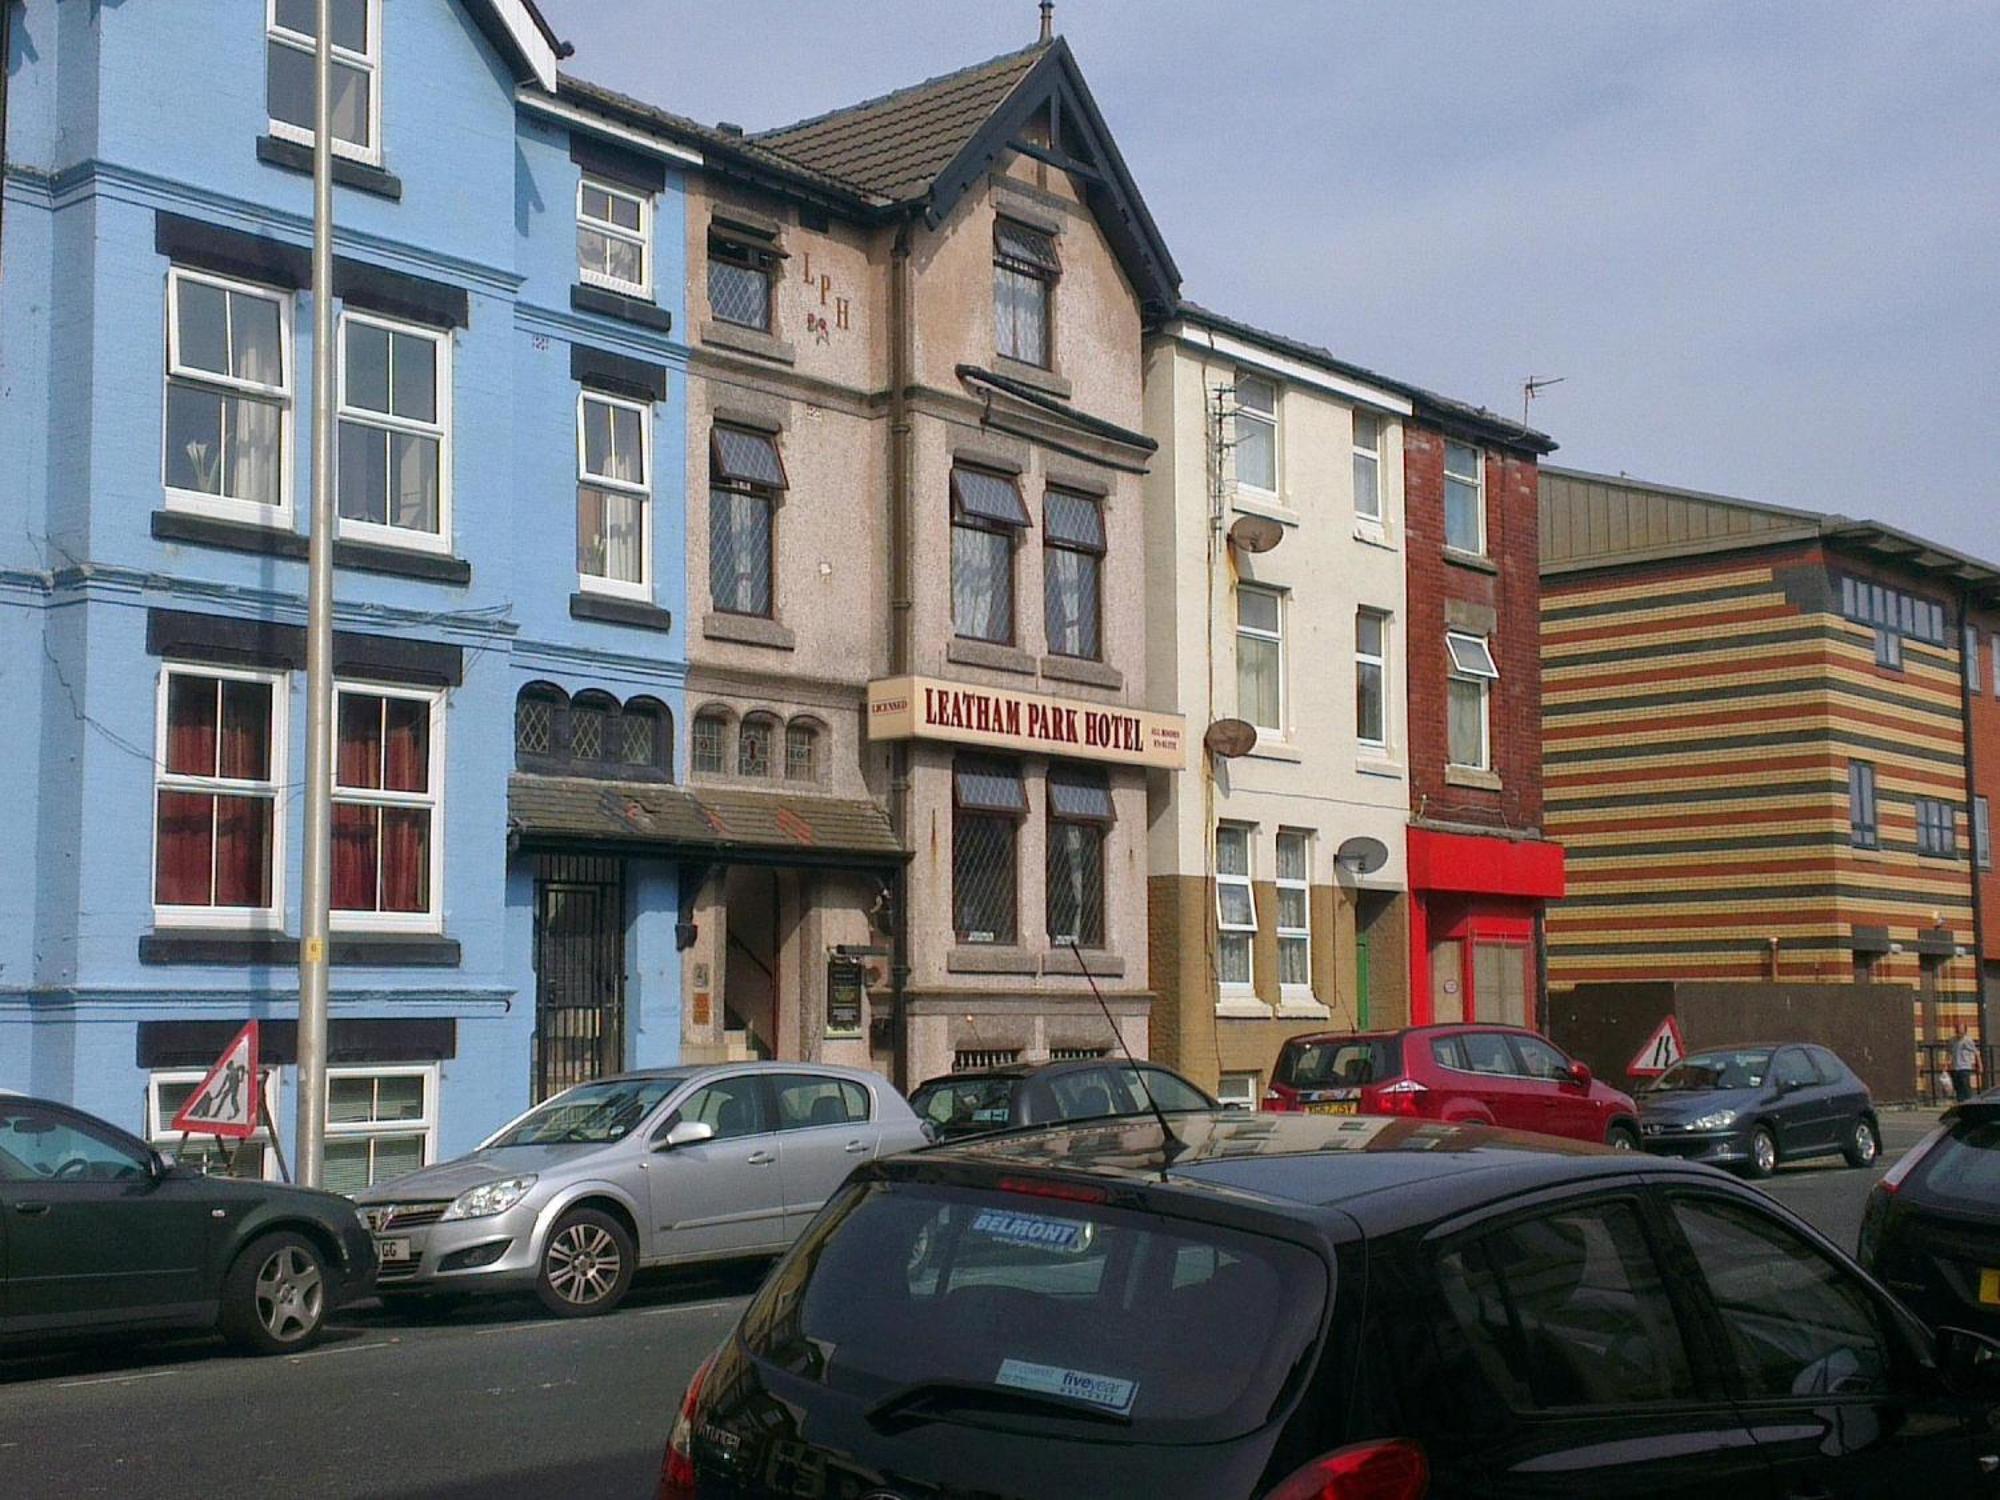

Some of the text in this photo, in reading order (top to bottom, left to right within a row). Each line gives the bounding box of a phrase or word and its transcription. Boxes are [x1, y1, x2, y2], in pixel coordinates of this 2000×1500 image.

[925, 688, 1144, 753] LEATHAM PARK HOTEL
[973, 1215, 1074, 1243] BELMONT
[382, 1242, 396, 1257] GG
